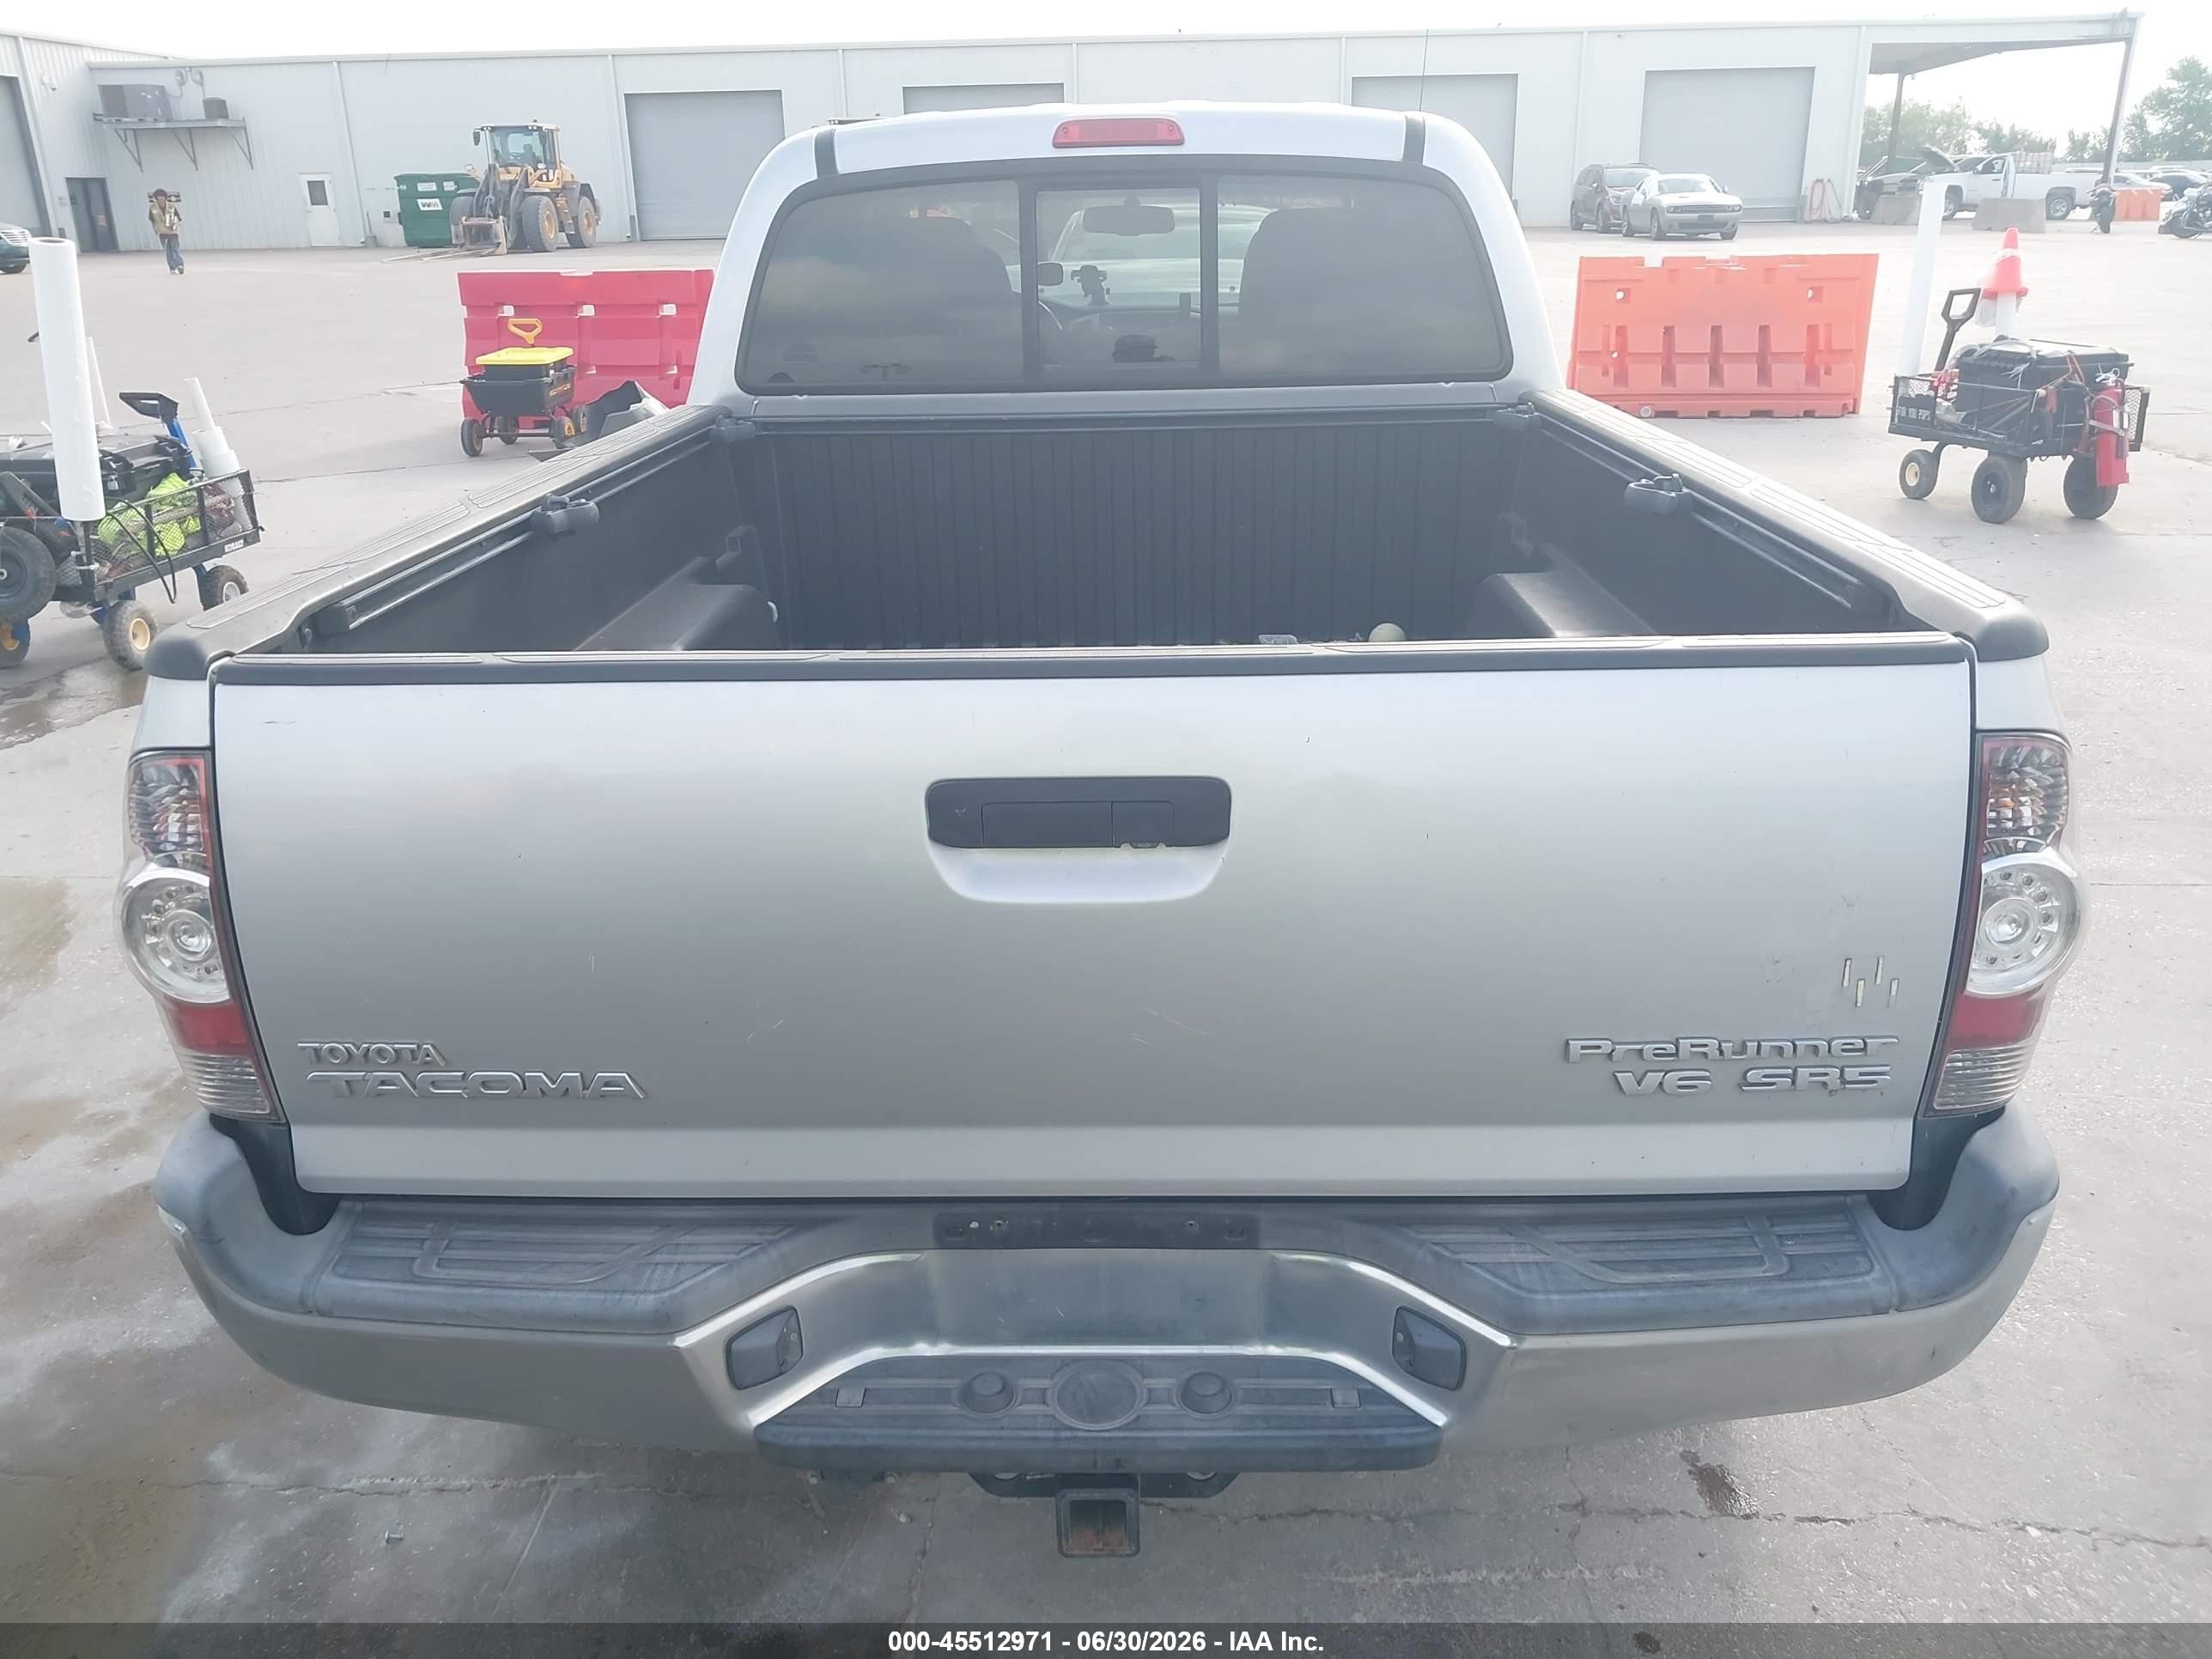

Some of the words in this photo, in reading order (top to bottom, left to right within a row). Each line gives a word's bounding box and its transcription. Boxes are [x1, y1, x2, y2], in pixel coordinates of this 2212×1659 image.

[297, 1042, 447, 1066] TOYOTA
[1566, 1036, 1900, 1063] PreRunner
[307, 1070, 647, 1099] TACOMA
[1613, 1068, 1713, 1096] V6
[1738, 1064, 1891, 1094] SR5
